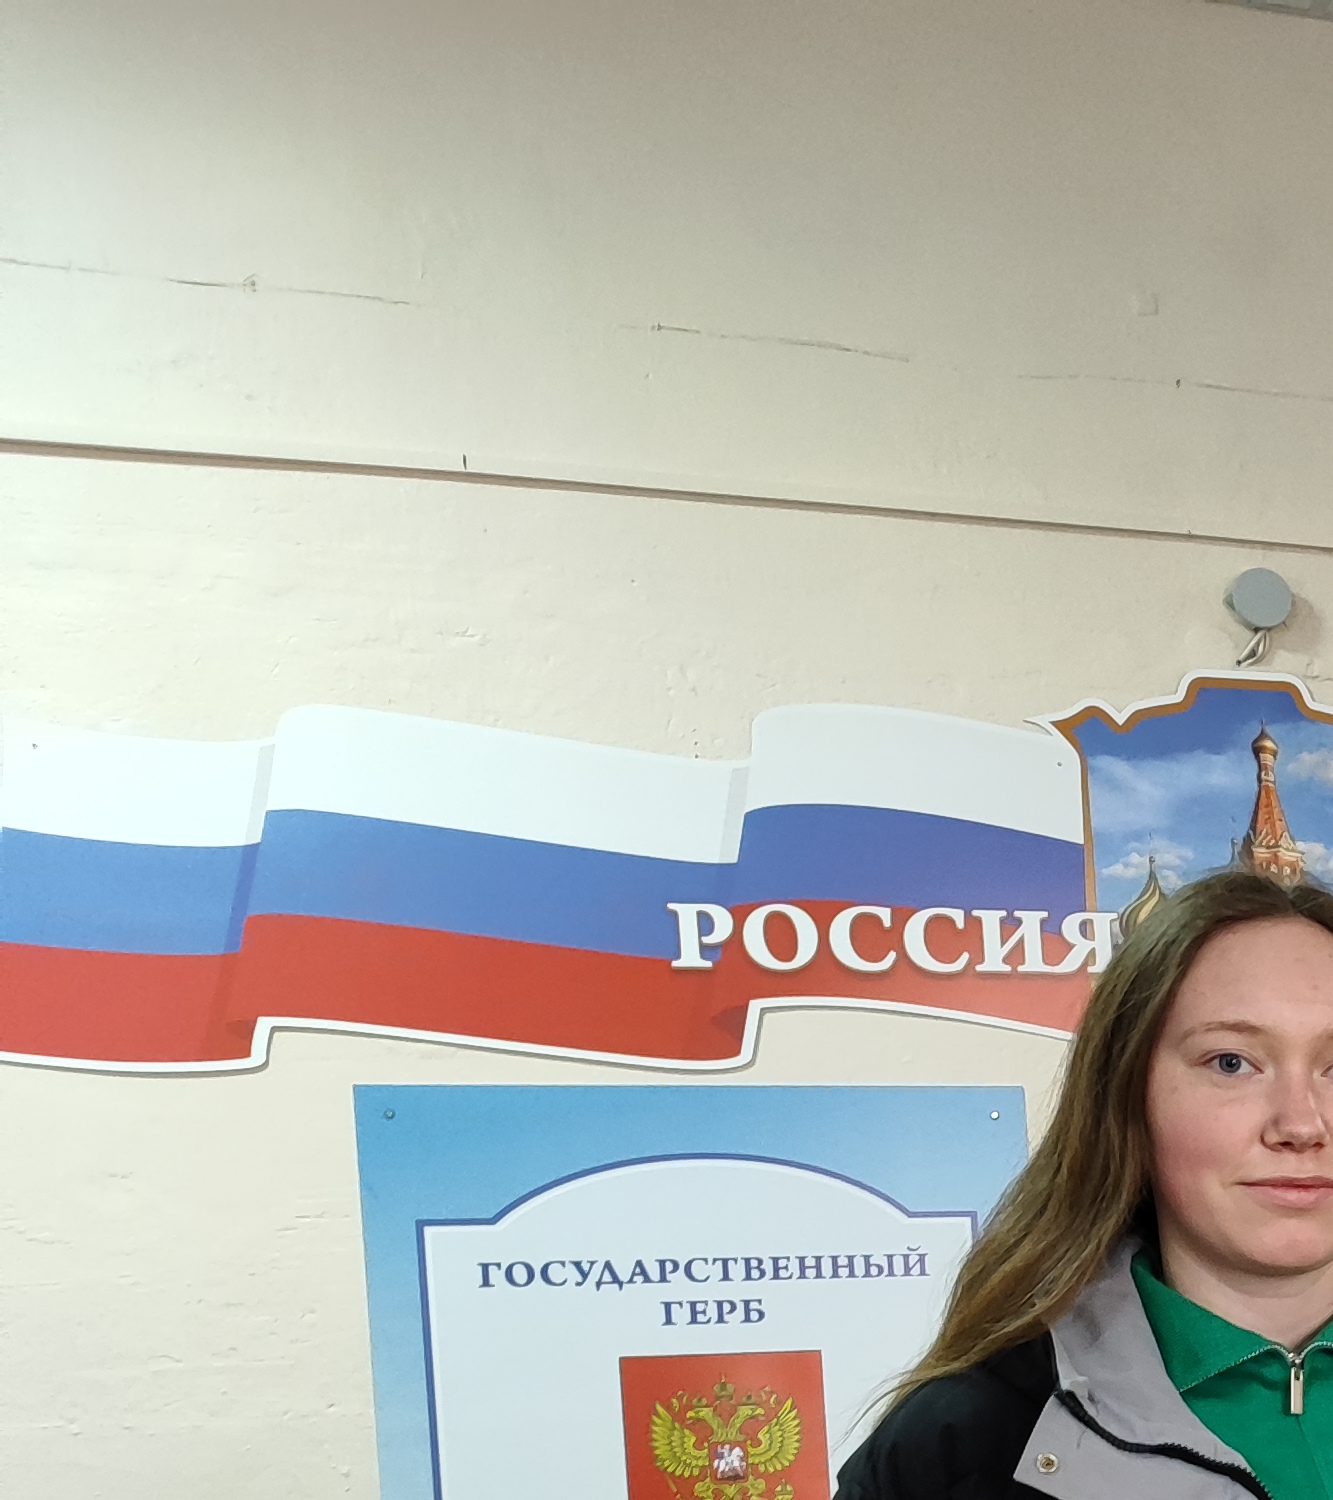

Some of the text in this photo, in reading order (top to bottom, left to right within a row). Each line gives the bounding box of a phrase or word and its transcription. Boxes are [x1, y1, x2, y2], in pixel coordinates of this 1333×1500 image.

[666, 902, 1118, 974] РОССИЯ
[477, 1246, 931, 1291] ГОСУДАРСТВЕННЫЙ
[660, 1298, 766, 1326] ГЕРБ
